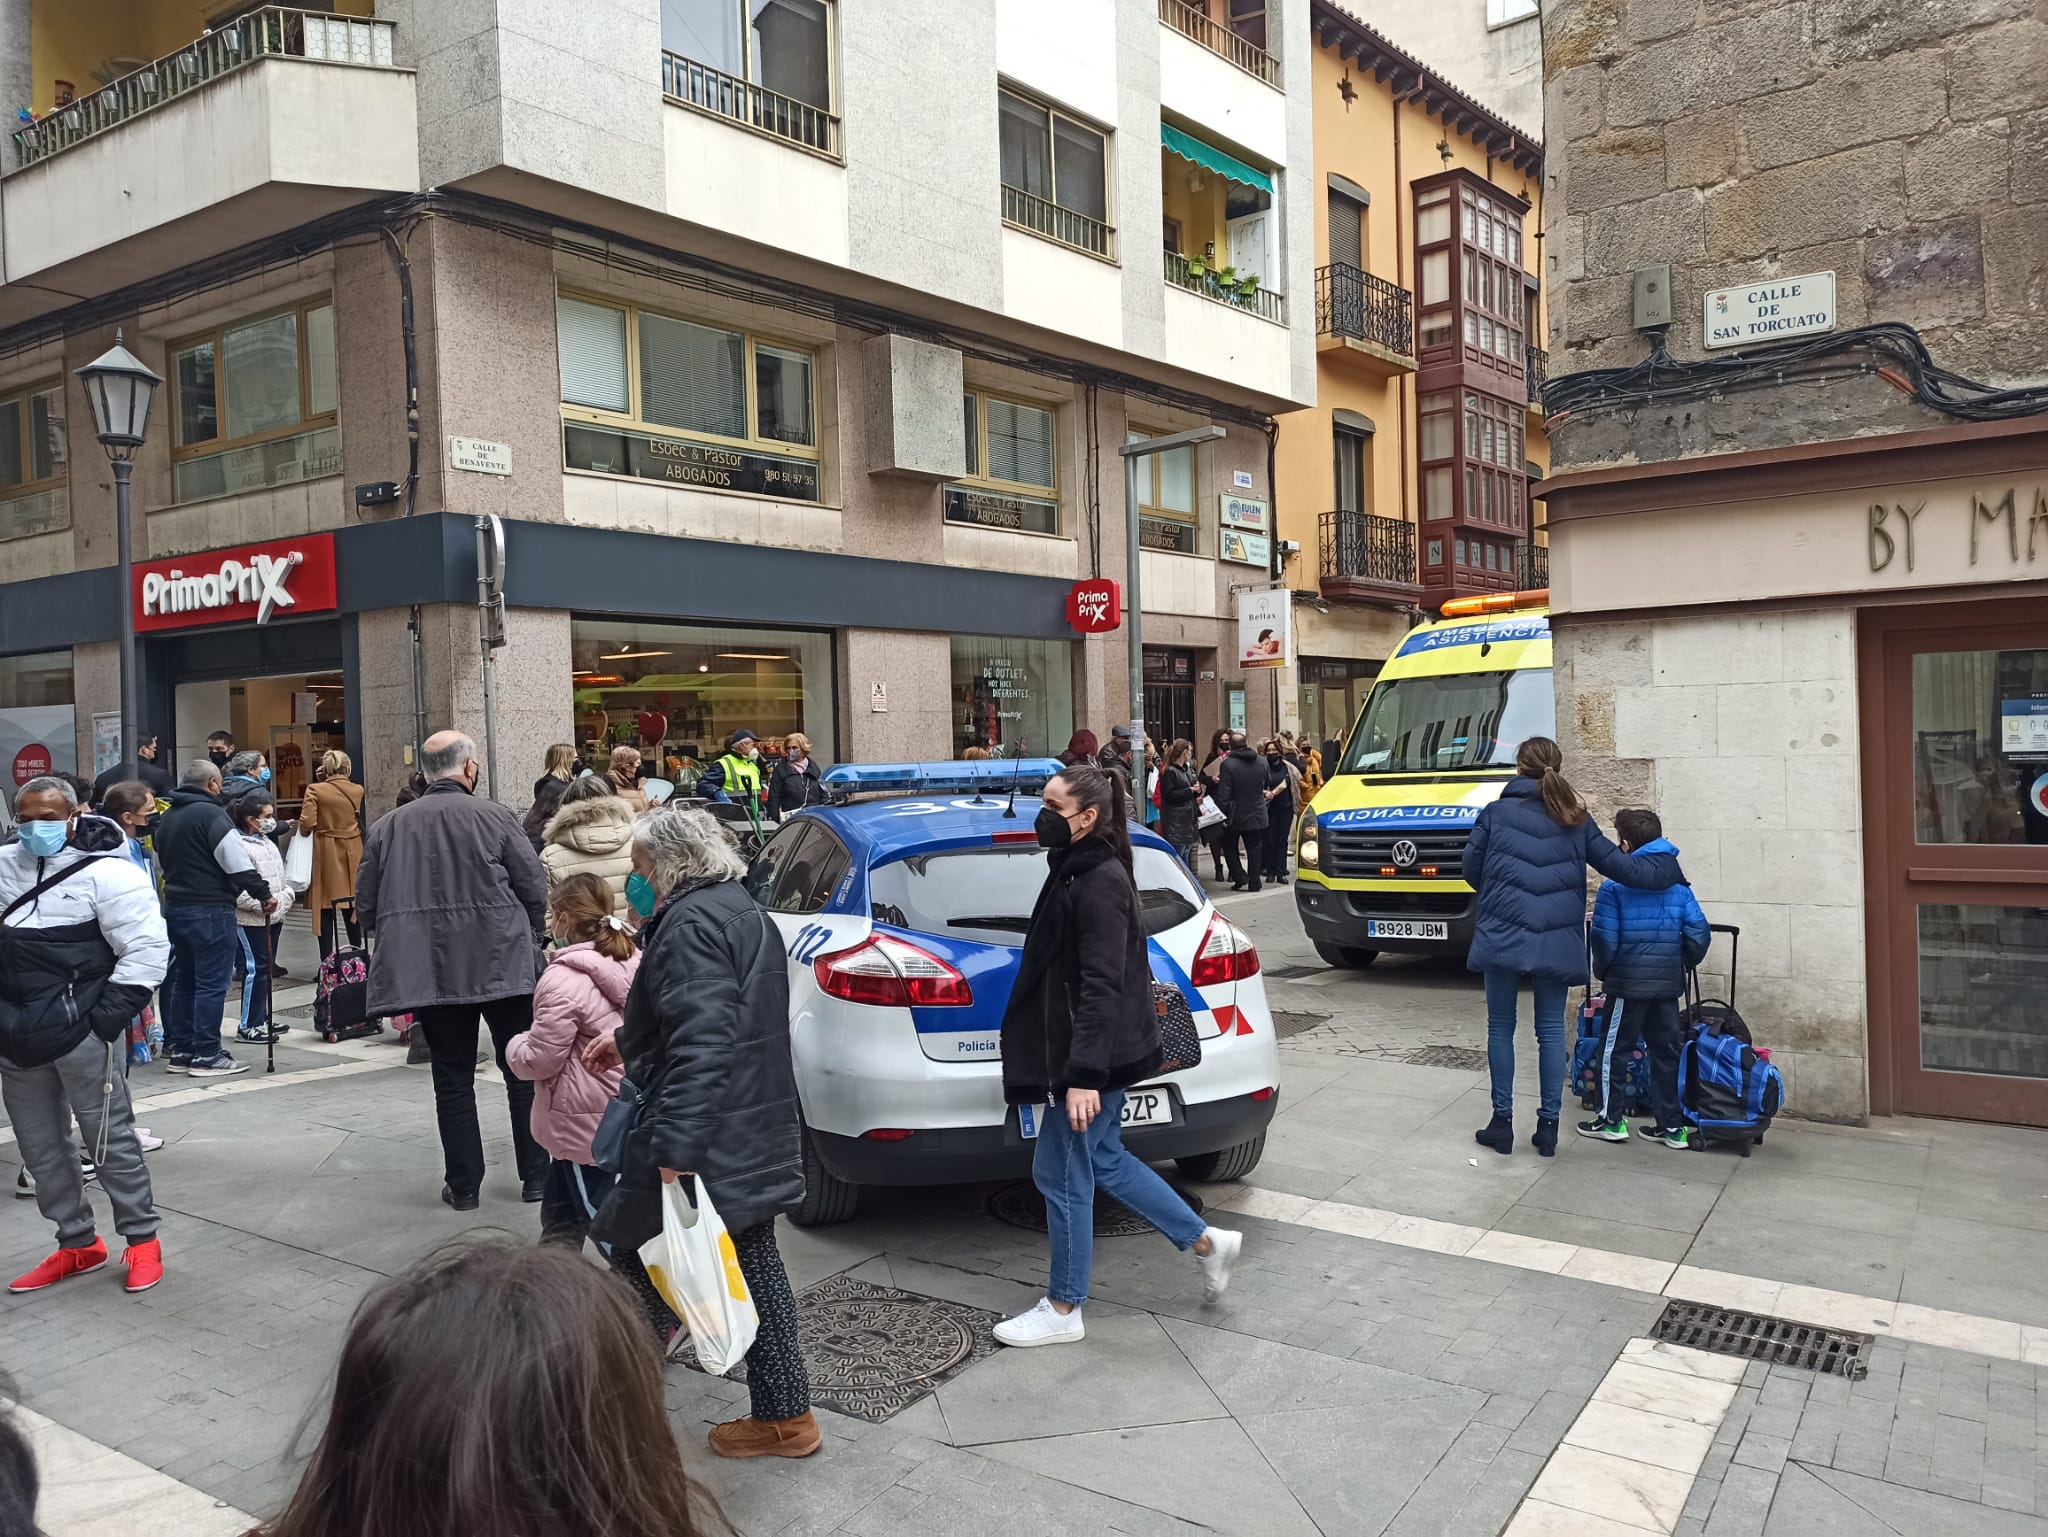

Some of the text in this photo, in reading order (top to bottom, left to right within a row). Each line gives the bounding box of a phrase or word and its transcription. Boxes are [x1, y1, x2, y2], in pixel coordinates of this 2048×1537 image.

[1748, 285, 1801, 304] CALLE
[1757, 304, 1780, 318] DE
[1713, 312, 1827, 340] SAN TORCUATO
[472, 443, 498, 453] CALLE
[649, 439, 742, 467] Esbec & Pastor
[477, 452, 489, 460] DE
[459, 458, 506, 470] BENAVENTE
[665, 464, 731, 486] ABOGADOS
[764, 469, 780, 481] 980
[804, 475, 815, 486] 35
[1241, 503, 1261, 515] EULEN
[976, 510, 1020, 527] ABOGADOS
[1140, 533, 1175, 549] ABOGADOS
[1868, 500, 1928, 574] BY
[1077, 590, 1109, 604] Prima
[1248, 612, 1277, 621] Bellax
[1425, 619, 1549, 639] AMBULANC
[983, 667, 1027, 682] DE OUTLET,
[992, 688, 1029, 698] DIFERENTES
[1378, 923, 1443, 937] 8928 JBM
[788, 923, 833, 967] 112
